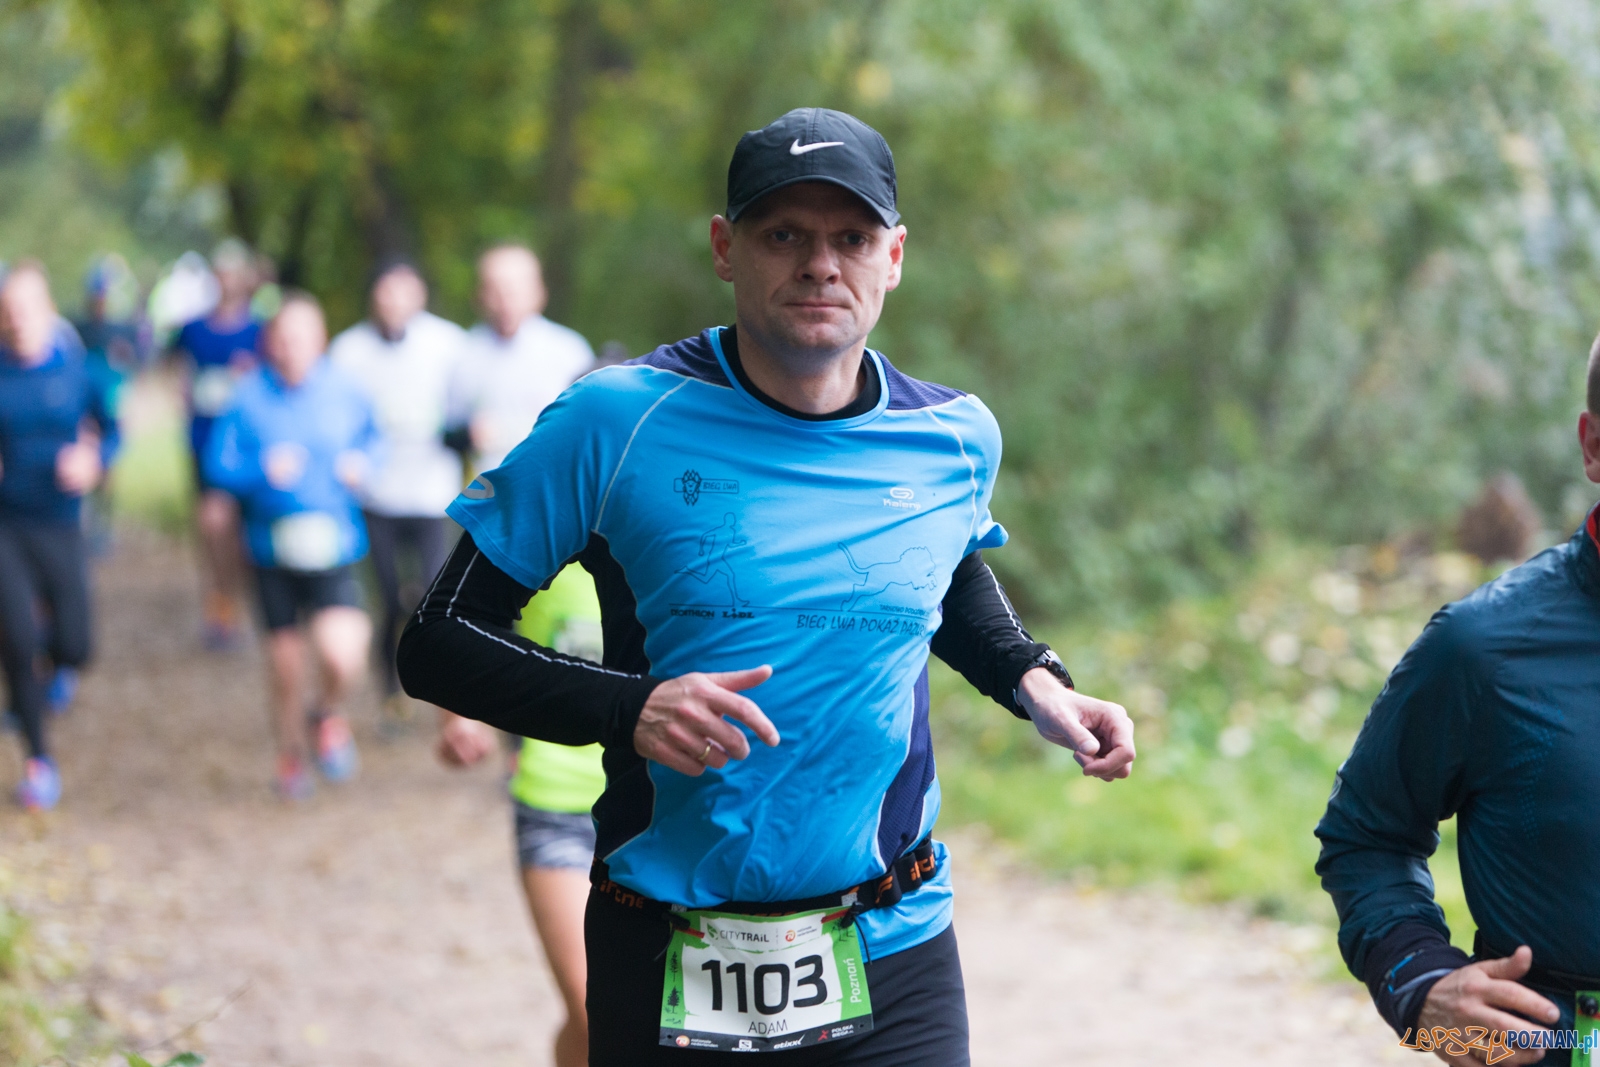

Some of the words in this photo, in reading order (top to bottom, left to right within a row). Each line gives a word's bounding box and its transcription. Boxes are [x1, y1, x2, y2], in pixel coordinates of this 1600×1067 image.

[796, 614, 827, 631] BIEG
[830, 615, 856, 631] LWA
[701, 954, 829, 1016] 1103
[842, 957, 862, 1004] Poznań
[748, 1019, 788, 1035] ADAM
